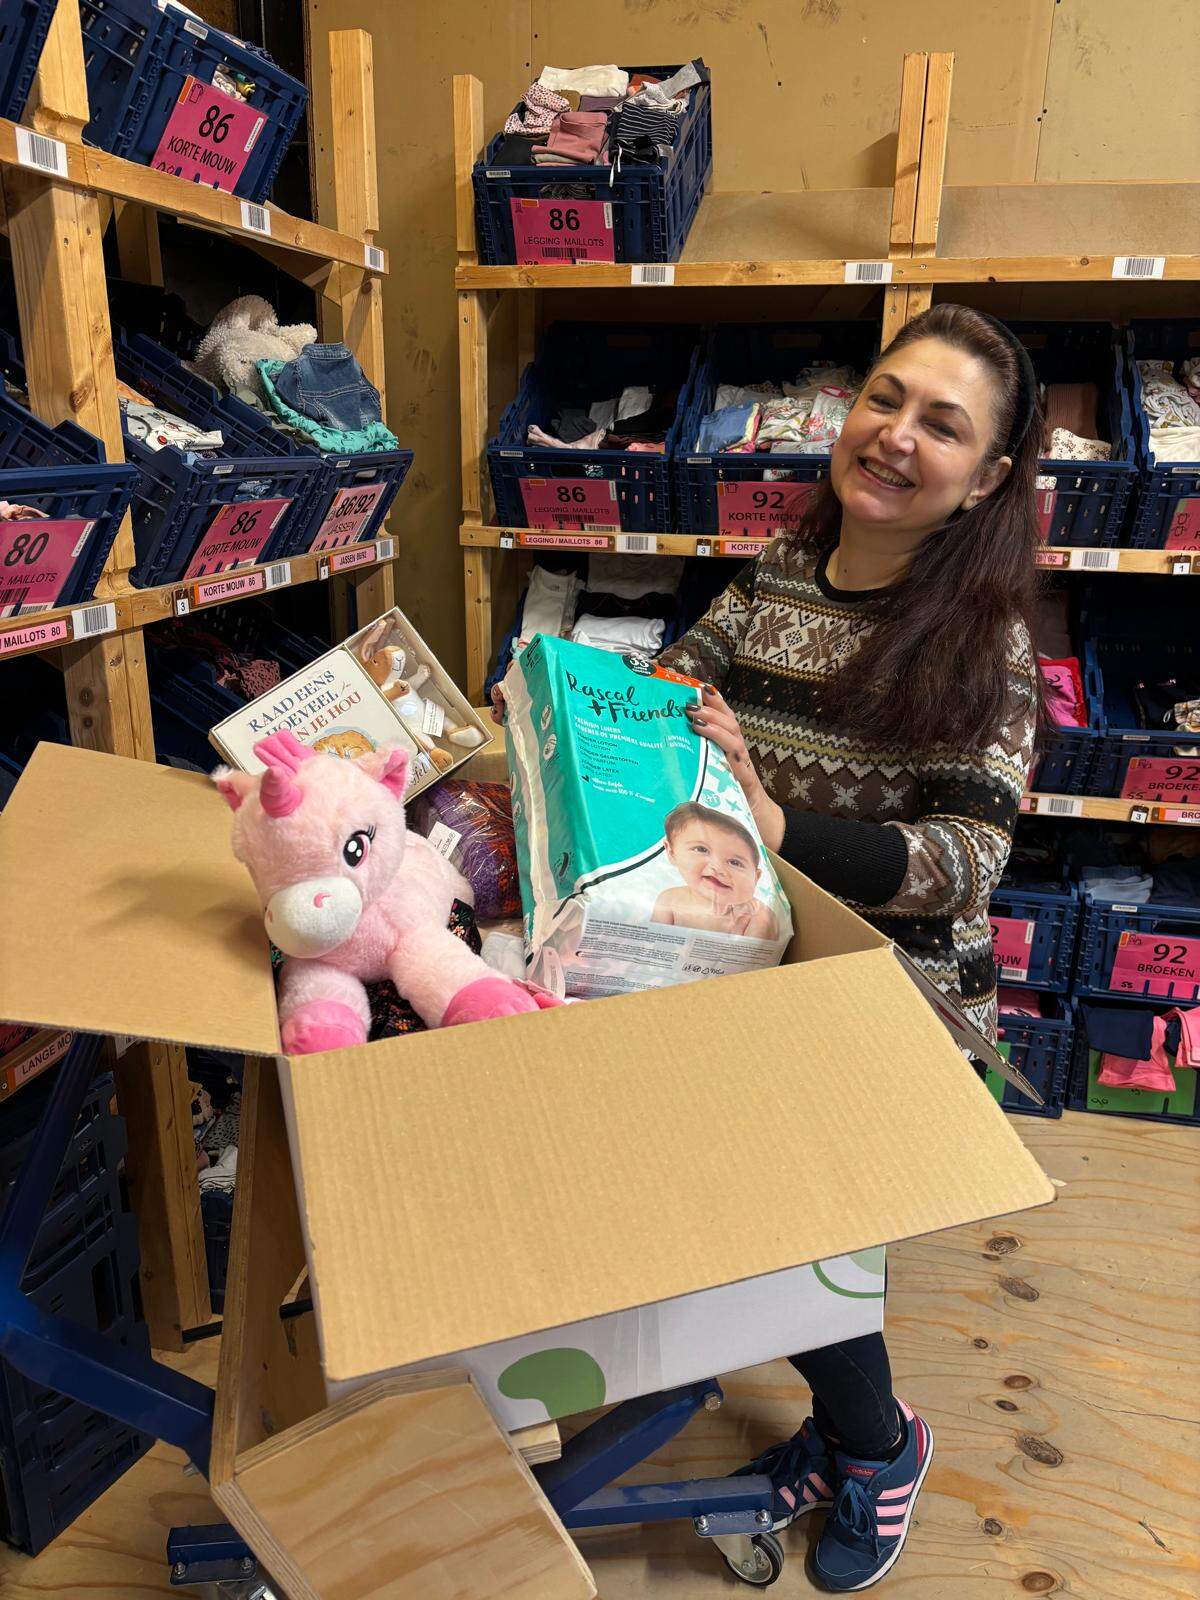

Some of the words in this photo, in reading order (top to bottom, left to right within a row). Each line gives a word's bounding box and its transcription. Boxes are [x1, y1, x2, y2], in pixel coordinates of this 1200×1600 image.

[199, 105, 235, 143] 86
[167, 136, 202, 161] KORTE
[200, 149, 238, 175] MOUW
[549, 208, 580, 231] 86
[523, 236, 560, 245] LEGGING
[564, 237, 605, 247] MAILLOTS
[556, 486, 586, 503] 86
[752, 491, 785, 509] 92
[336, 493, 376, 519] 86/92
[572, 507, 610, 515] MAILLOTS
[229, 509, 263, 536] 86
[728, 512, 766, 521] KORTE
[769, 512, 800, 522] MOU
[328, 521, 358, 535] JASSEN
[4, 532, 49, 567] 80
[200, 541, 232, 558] KORTE
[230, 537, 263, 553] MOUW
[731, 543, 760, 551] KORTE
[339, 554, 356, 566] JASSEN
[8, 572, 58, 585] MAILLOTS
[203, 584, 226, 597] KORTE
[226, 580, 246, 592] MOUW
[248, 577, 256, 587] 86
[180, 602, 186, 612] 3
[4, 629, 46, 648] MAILLOTS
[51, 626, 61, 637] 80
[565, 669, 640, 706] Rascal
[248, 697, 295, 733] RAAD
[294, 670, 335, 702] EENS
[310, 714, 329, 733] JE
[327, 691, 362, 721] HOU
[1164, 765, 1200, 781] 92
[1148, 782, 1200, 791] BROEKE
[1136, 813, 1142, 821] 3
[1181, 811, 1200, 819] BRO
[991, 925, 999, 943] 2
[993, 953, 1022, 966] OUW
[1153, 943, 1188, 964] 92
[1137, 963, 1196, 978] BROEKEN
[22, 1046, 56, 1075] LANGE
